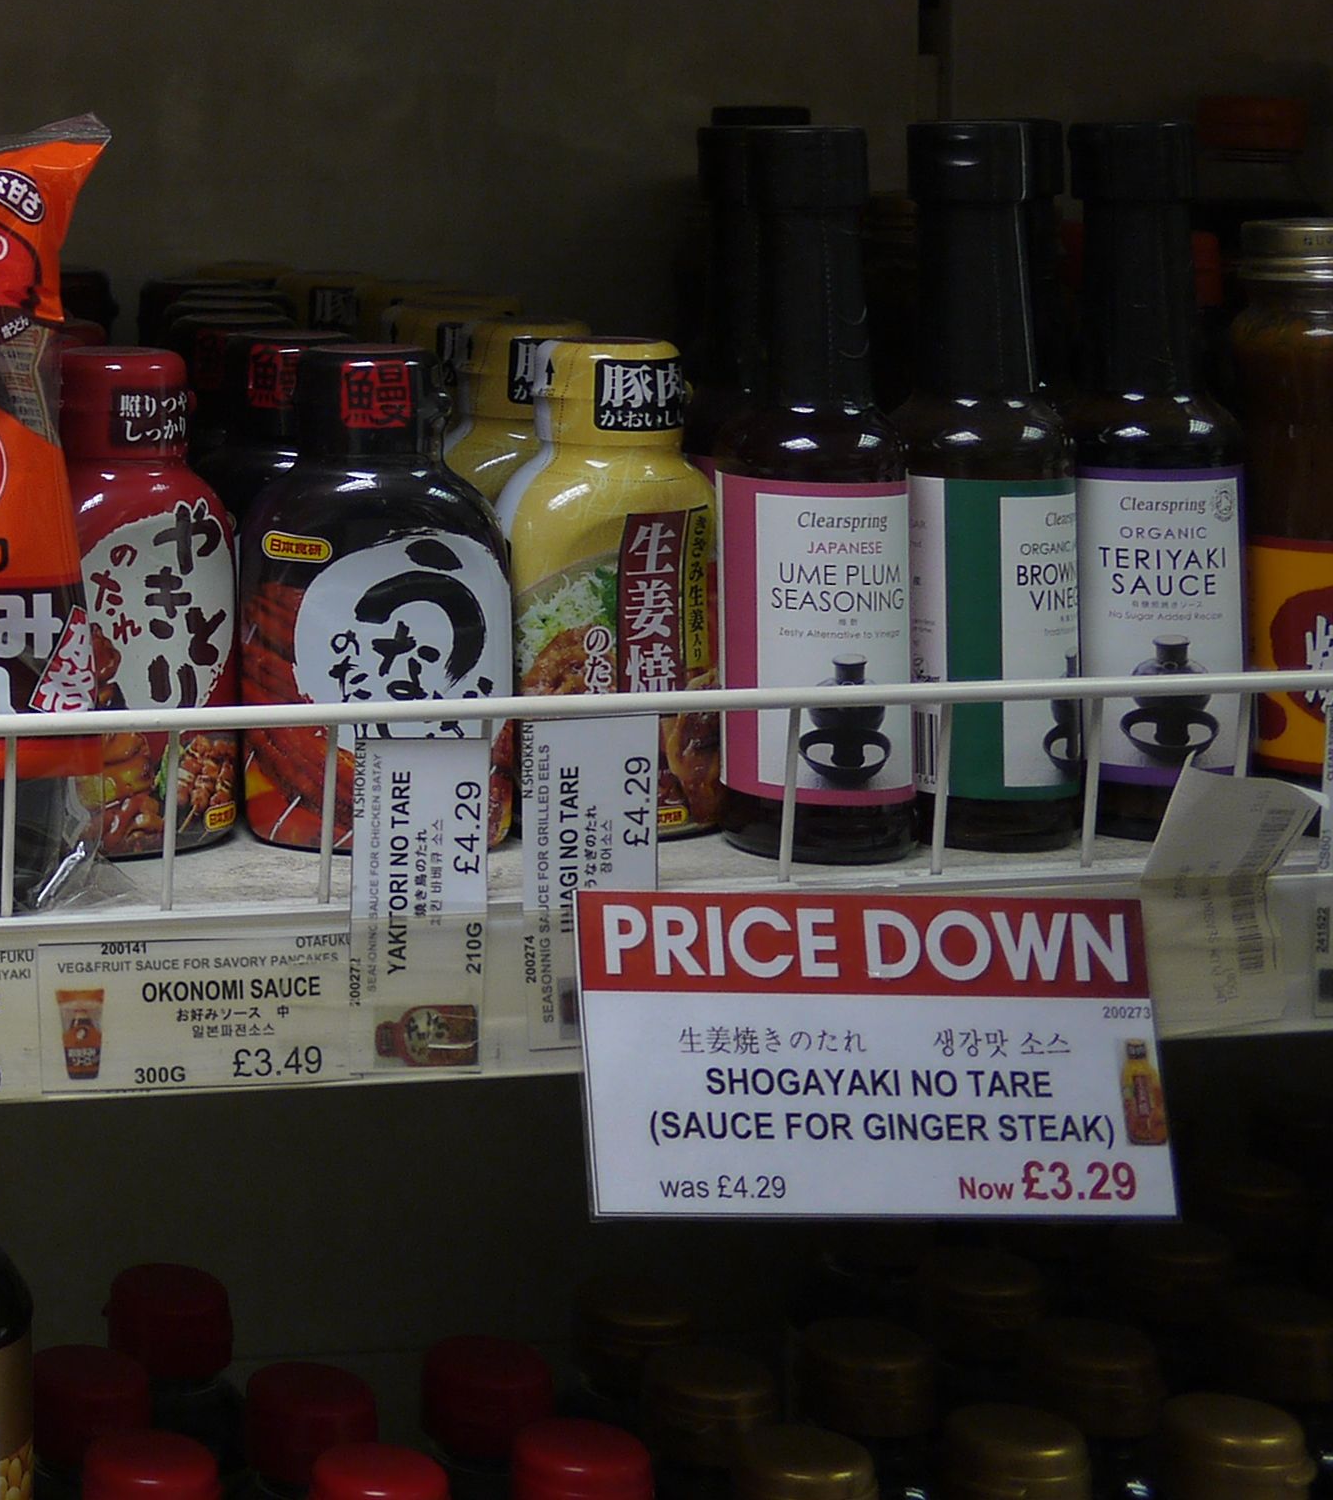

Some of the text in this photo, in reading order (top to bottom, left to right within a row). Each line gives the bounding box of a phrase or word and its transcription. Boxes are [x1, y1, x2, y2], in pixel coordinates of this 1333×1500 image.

[797, 511, 888, 532] Clearspring
[1119, 526, 1208, 540] ORGANIC
[807, 541, 883, 555] JAPANESE
[1099, 547, 1227, 570] TERIYAKI
[779, 562, 901, 587] UME PLUM
[1111, 572, 1217, 596] SAUCE
[771, 588, 904, 613] SEASONING
[560, 766, 579, 859] NO TARE
[623, 757, 650, 846] £4.29
[453, 781, 481, 874] £4.29
[387, 771, 410, 974] YAKITORI NO TARE
[602, 904, 837, 979] PRICE
[862, 908, 1129, 983] DOWN
[142, 976, 321, 1002] OKONOMI SAUCE
[1103, 1006, 1151, 1019] 200273
[679, 1026, 867, 1056] 生姜焼きのたれ
[933, 1028, 1071, 1058] 생강맛 소스
[233, 1046, 322, 1077] £3.49
[706, 1068, 1052, 1098] SHOGAYAKI NO TARE
[650, 1110, 1115, 1148] (SAUCE FOR GINGER STEAK)
[660, 1175, 786, 1199] was £4.29
[960, 1160, 1137, 1201] Now £3.29
